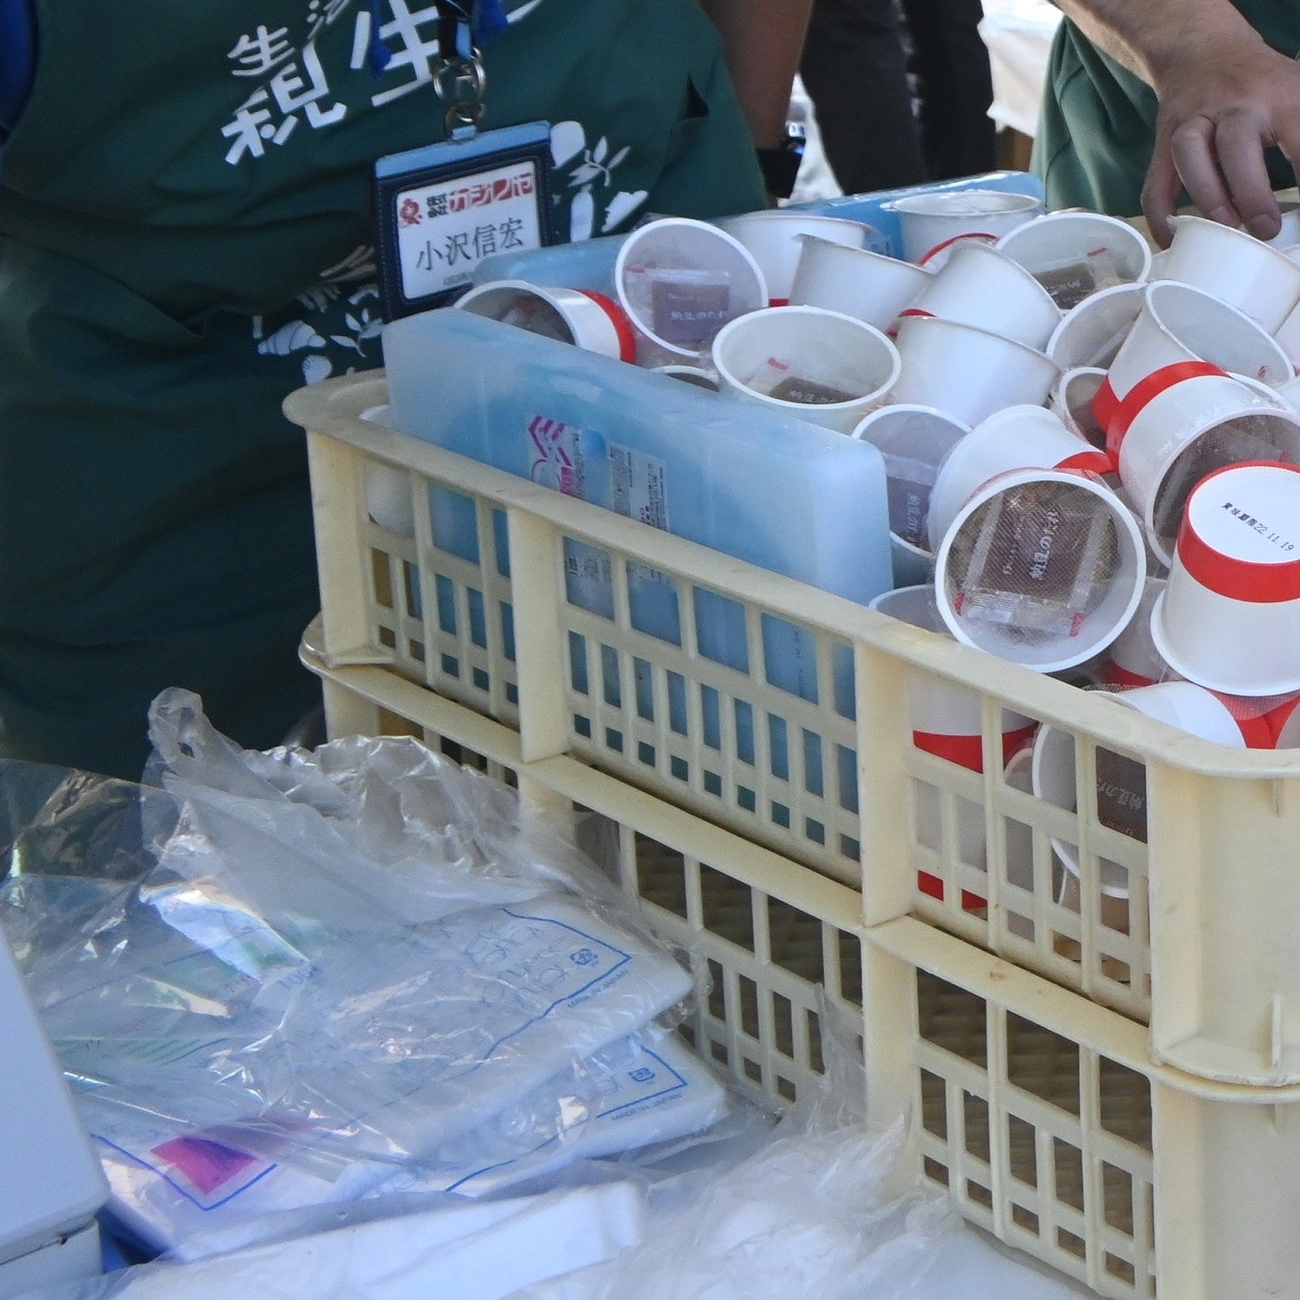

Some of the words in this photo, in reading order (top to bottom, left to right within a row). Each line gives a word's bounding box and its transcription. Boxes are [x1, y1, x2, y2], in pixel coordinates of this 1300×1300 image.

[416, 217, 524, 271] 小沢信宏
[1029, 509, 1060, 581] 納豆のたれ
